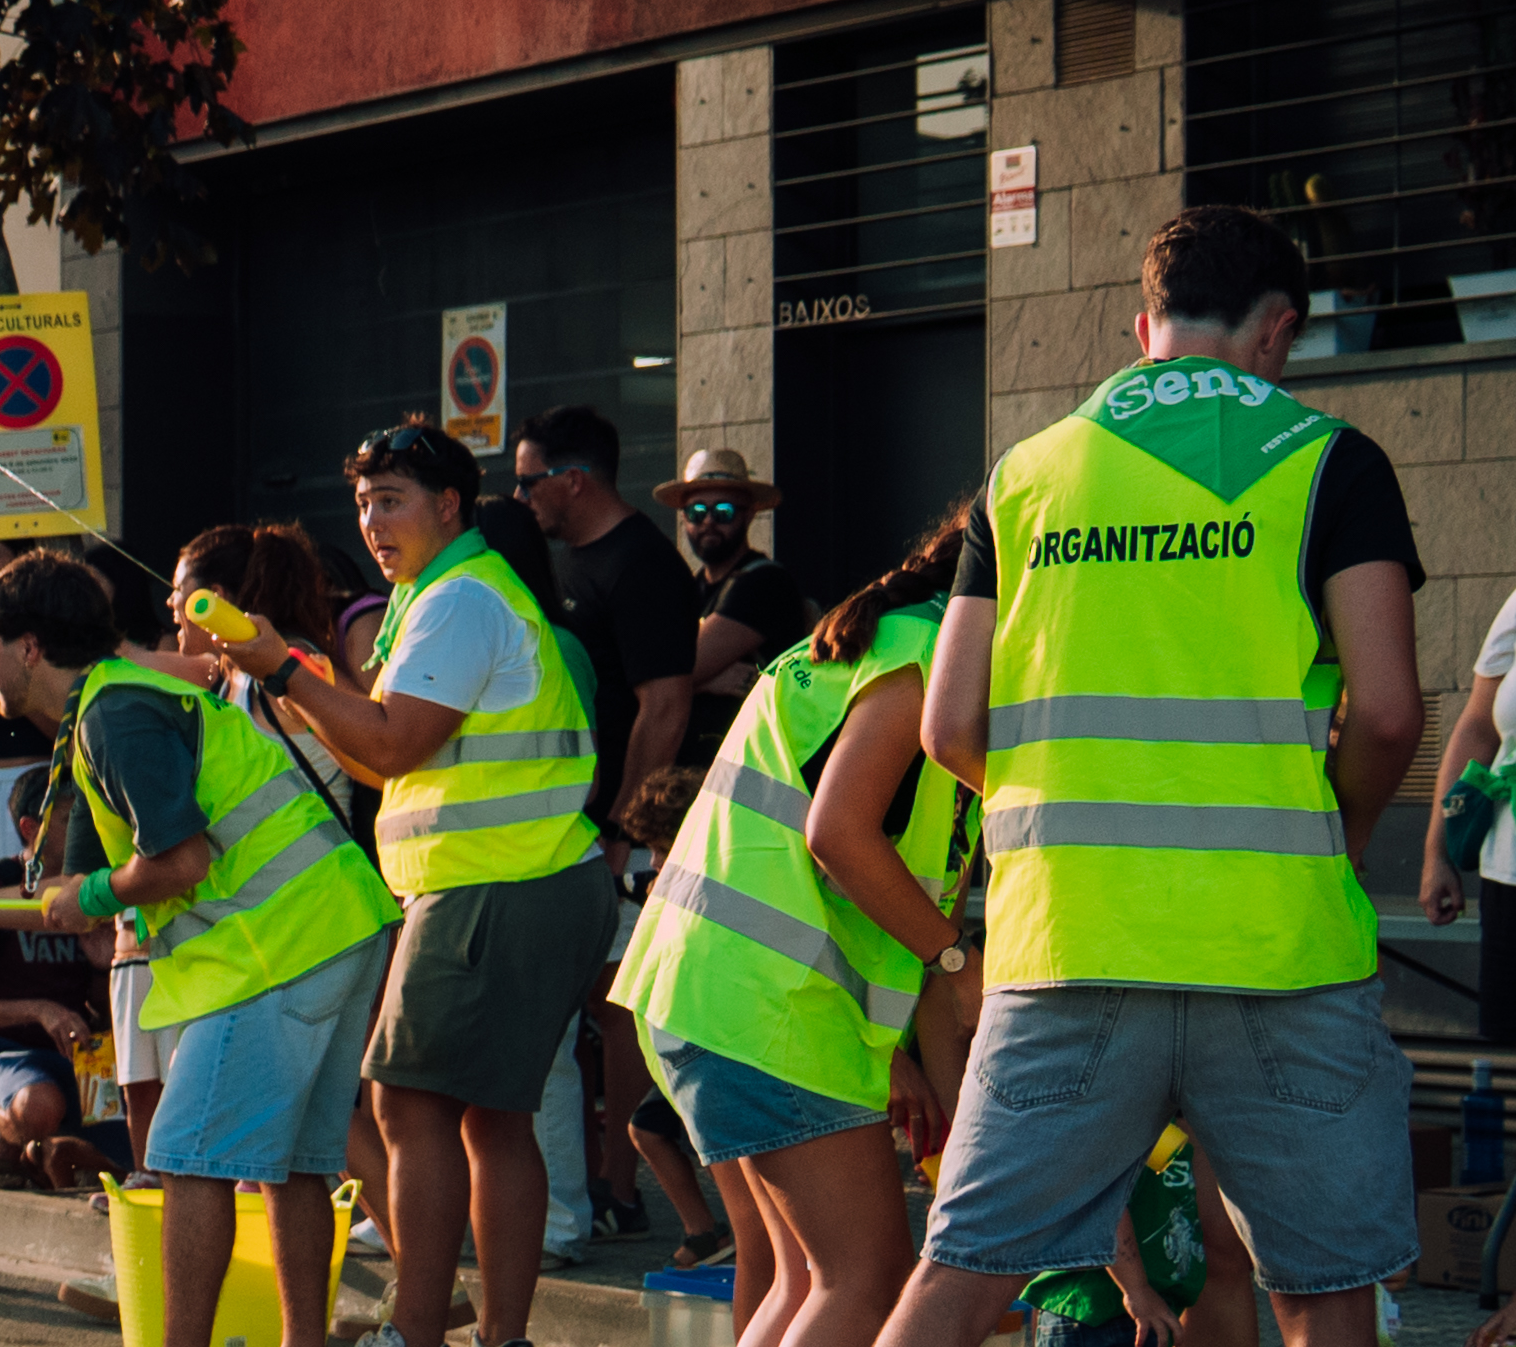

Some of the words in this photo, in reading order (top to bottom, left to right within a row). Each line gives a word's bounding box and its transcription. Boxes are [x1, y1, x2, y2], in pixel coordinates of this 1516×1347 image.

[779, 294, 871, 327] BAIXOS
[1260, 431, 1292, 454] FESTA
[1028, 511, 1255, 569] ORGANITZACIÓ
[17, 930, 86, 964] VAN
